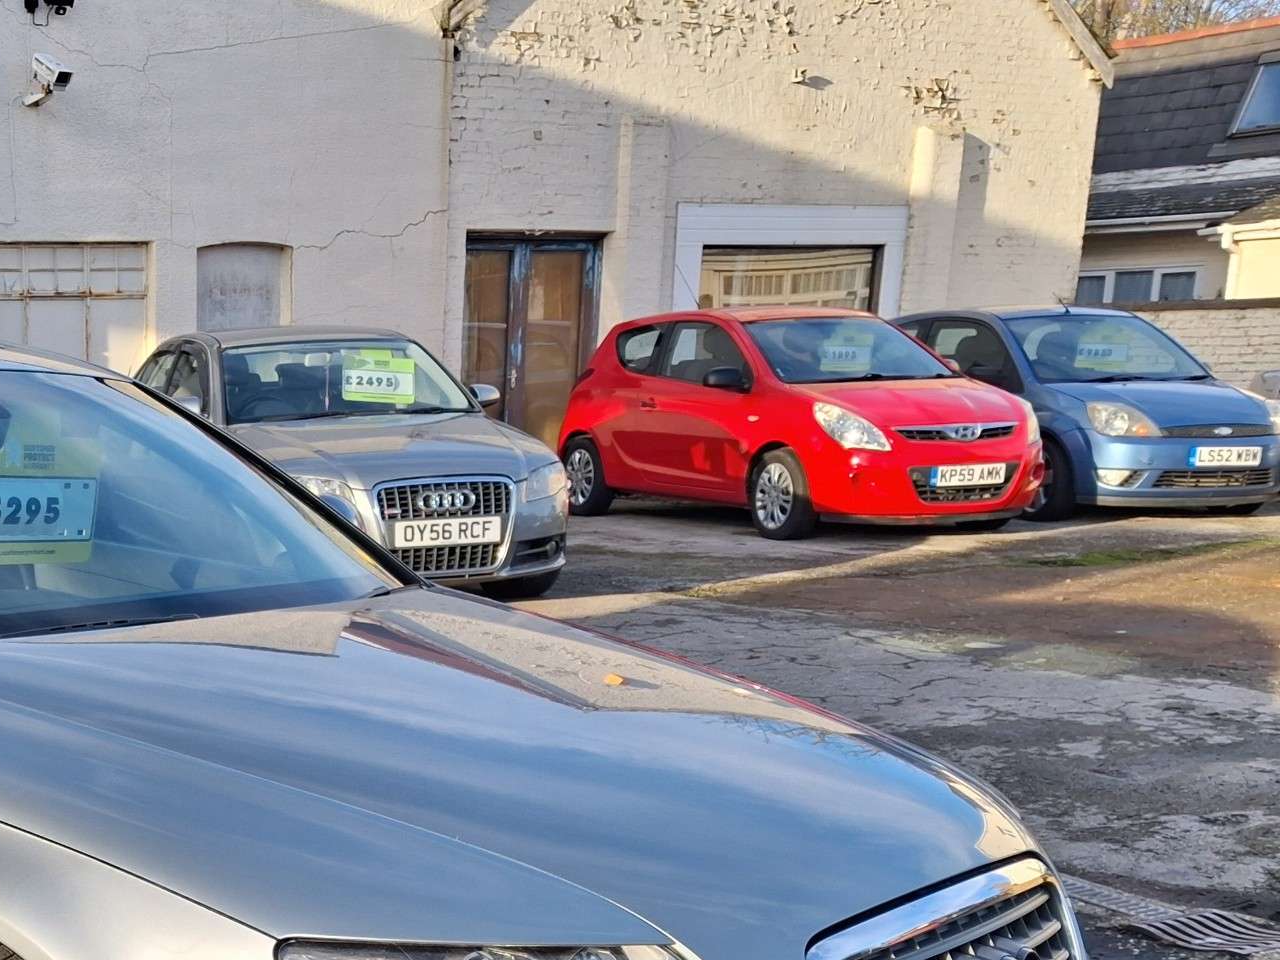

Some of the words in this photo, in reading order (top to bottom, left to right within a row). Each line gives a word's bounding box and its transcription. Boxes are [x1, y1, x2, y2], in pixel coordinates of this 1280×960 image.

[345, 375, 394, 388] £2495
[1198, 448, 1233, 463] LS52
[939, 468, 975, 483] KP59
[978, 466, 1002, 481] AMK
[404, 522, 453, 542] OY56
[458, 520, 493, 539] RCF
